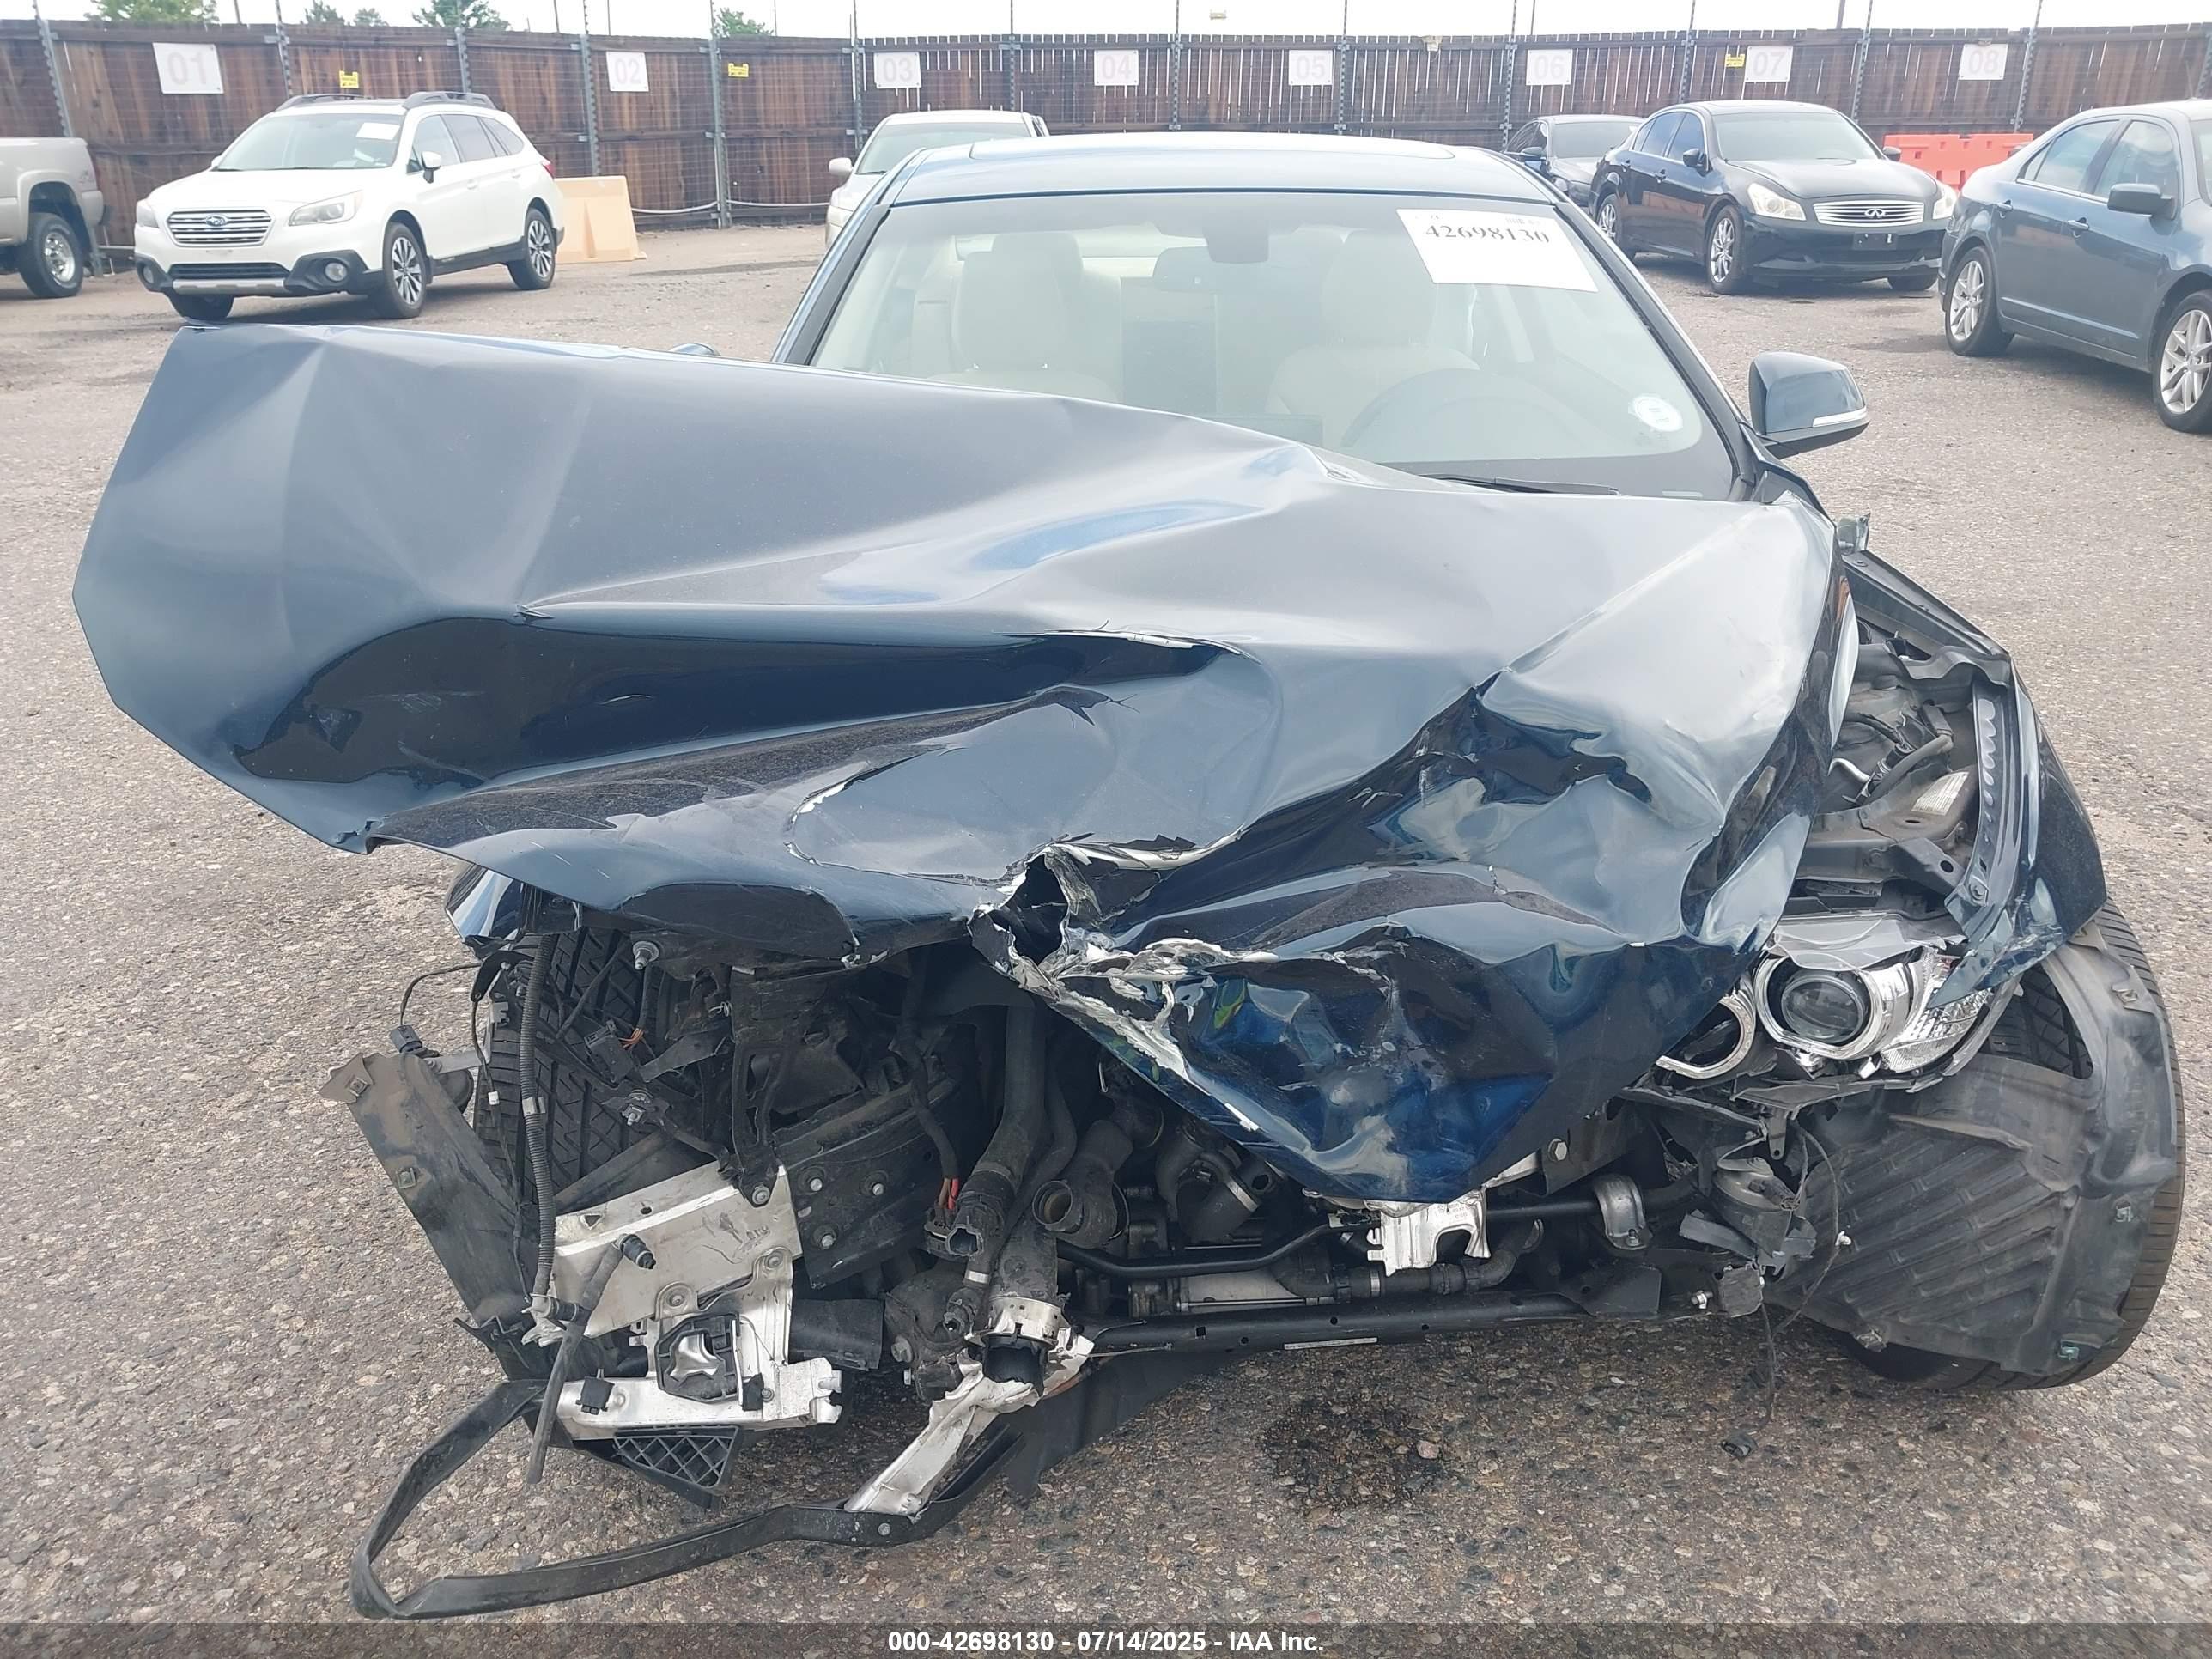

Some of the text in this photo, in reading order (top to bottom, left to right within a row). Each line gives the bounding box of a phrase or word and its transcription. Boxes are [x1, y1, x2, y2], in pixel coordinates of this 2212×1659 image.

[167, 52, 210, 86] 01
[614, 57, 641, 84] 02
[882, 58, 913, 82] 03
[1102, 55, 1131, 80] 04
[1296, 55, 1325, 80] 05
[1535, 55, 1565, 80] 06
[1753, 52, 1786, 77] 07
[1968, 50, 1999, 76] 08
[1425, 224, 1550, 243] 42698130
